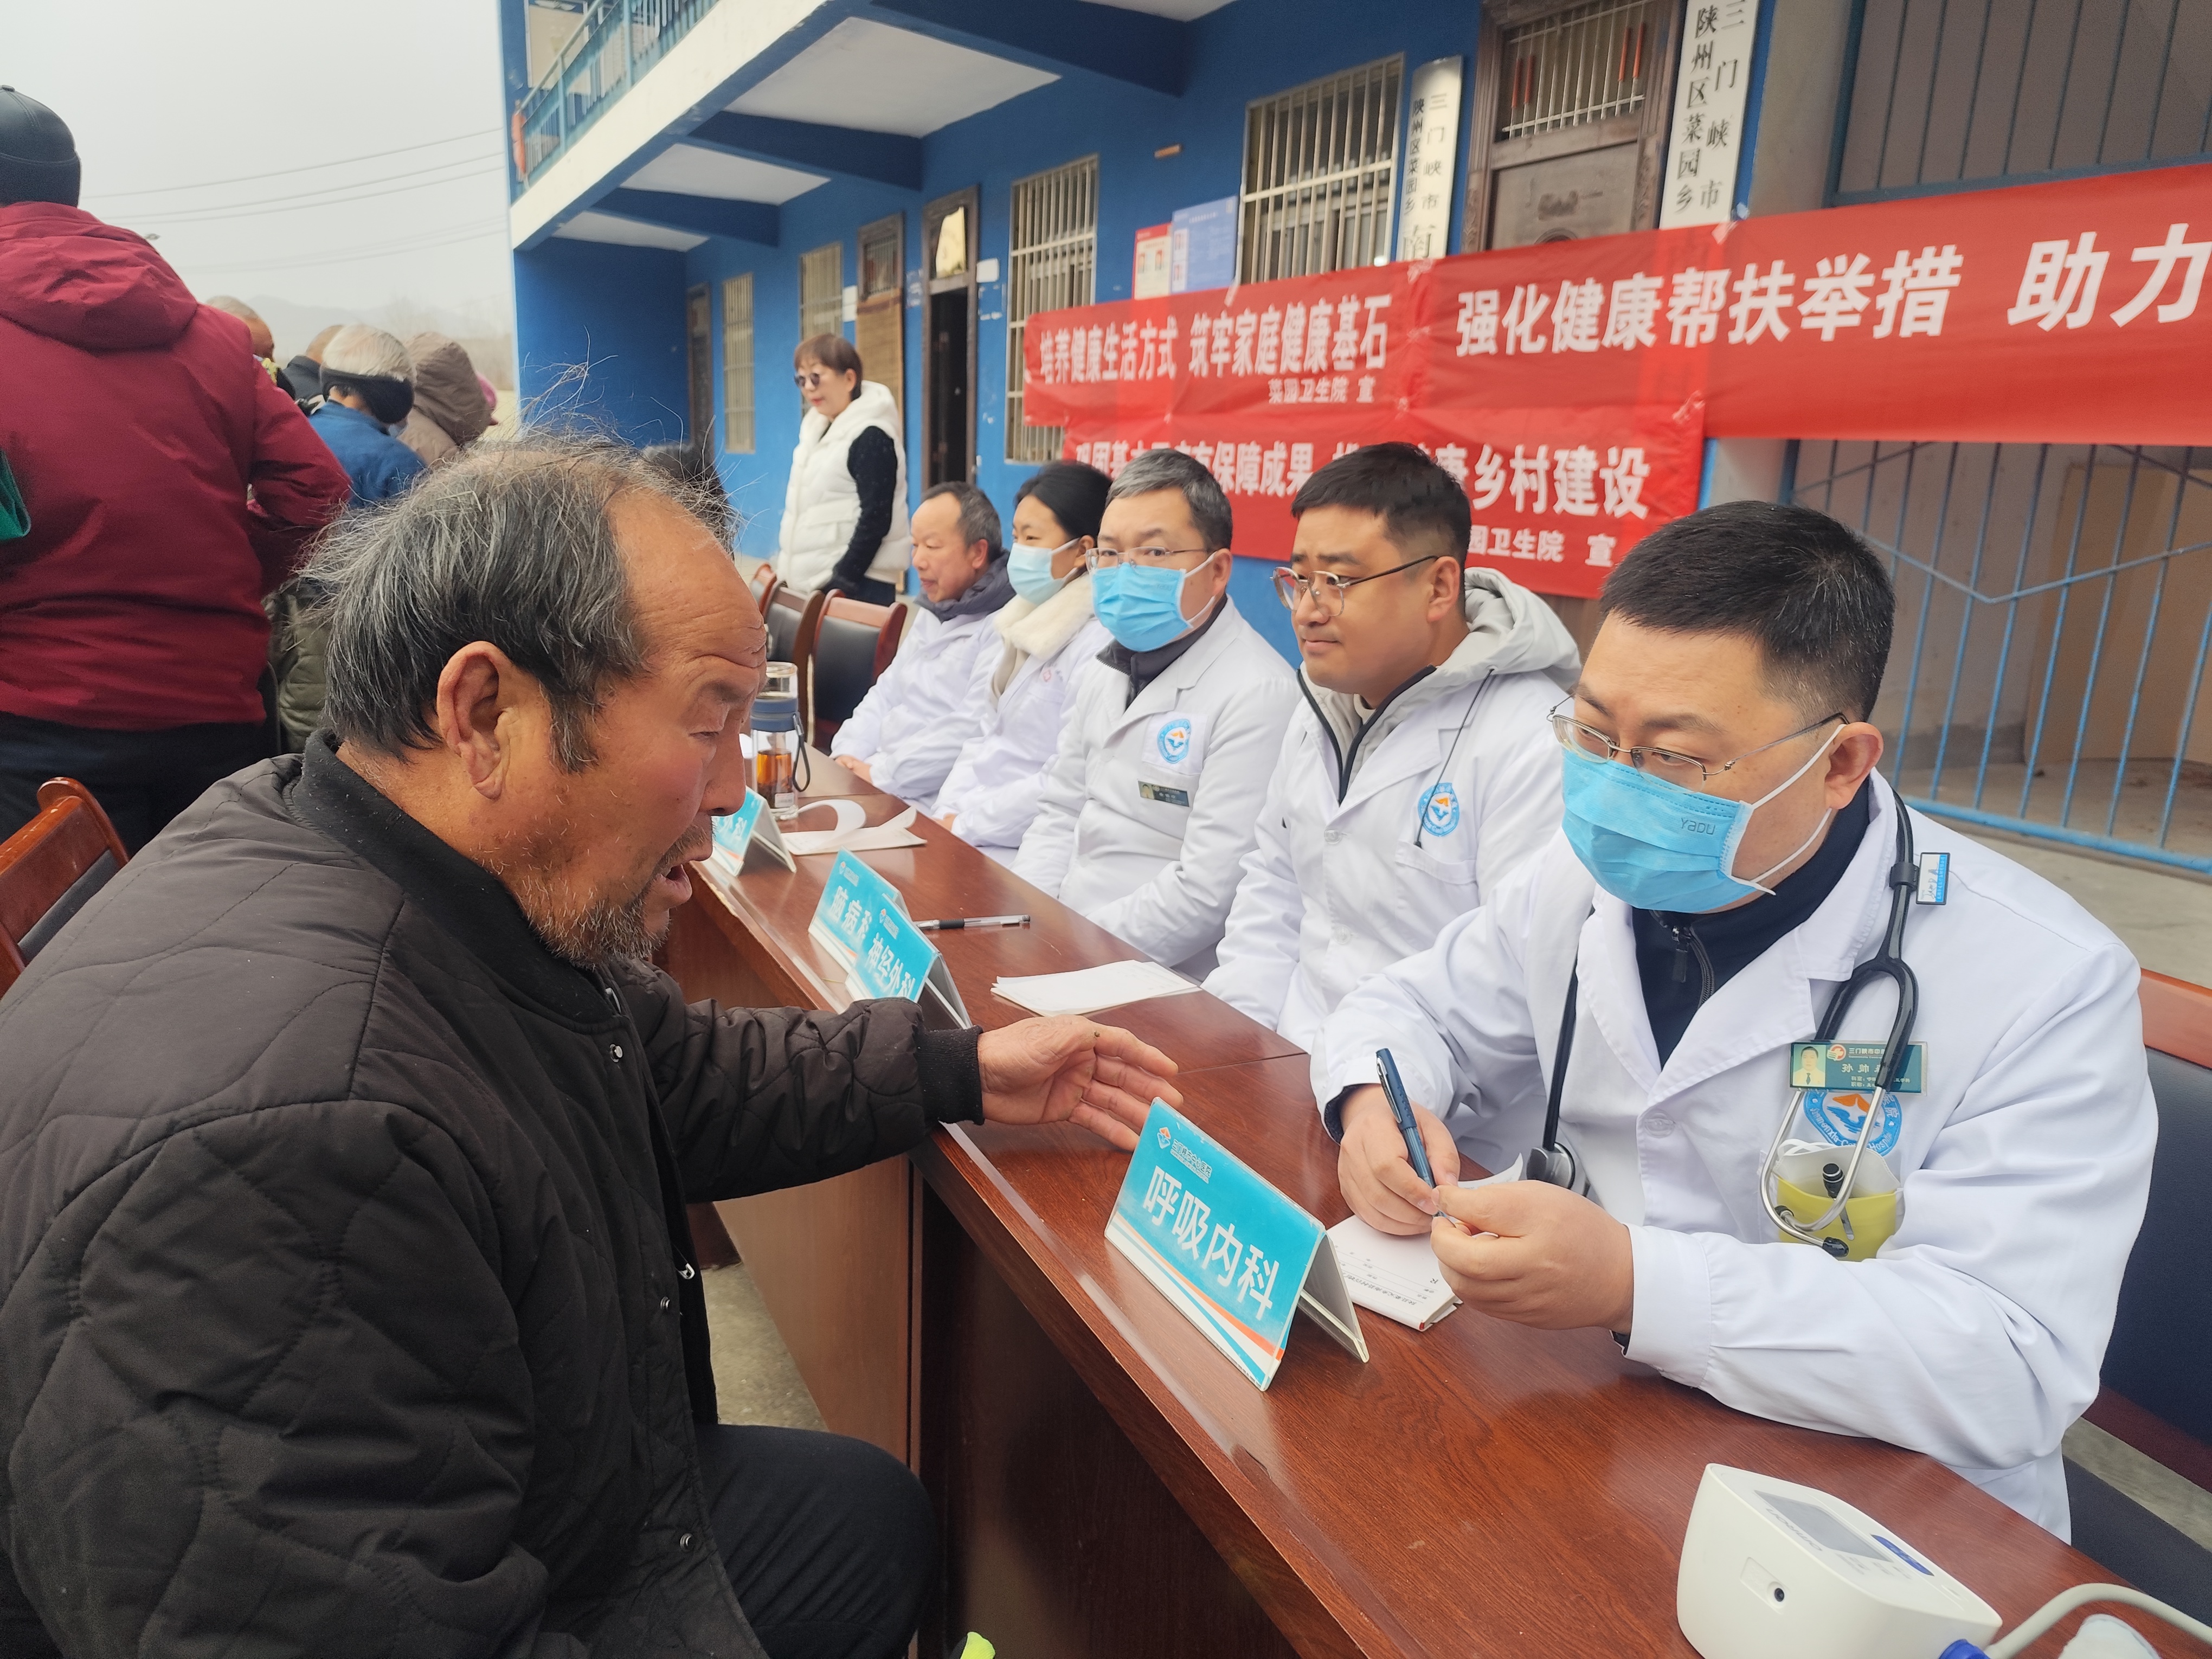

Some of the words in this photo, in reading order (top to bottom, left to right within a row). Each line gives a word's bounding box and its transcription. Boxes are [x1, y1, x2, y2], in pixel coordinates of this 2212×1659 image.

[1422, 93, 1449, 210] 三门峡市
[1675, 4, 1718, 214] 陕州区菜园乡
[1700, 3, 1747, 210] 三门峡市
[1040, 316, 1178, 384] 培养健康生活方式
[1188, 293, 1392, 378] 筑牢家庭健康基石
[1455, 244, 1964, 357] 强化健康帮扶举措
[2008, 223, 2212, 332] 助力
[1268, 376, 1349, 404] 菜园卫生院
[1356, 376, 1375, 403] 宣
[1584, 533, 1616, 568] 宣
[864, 932, 916, 998] 神经外科
[1142, 1165, 1279, 1321] 呼吸内科
